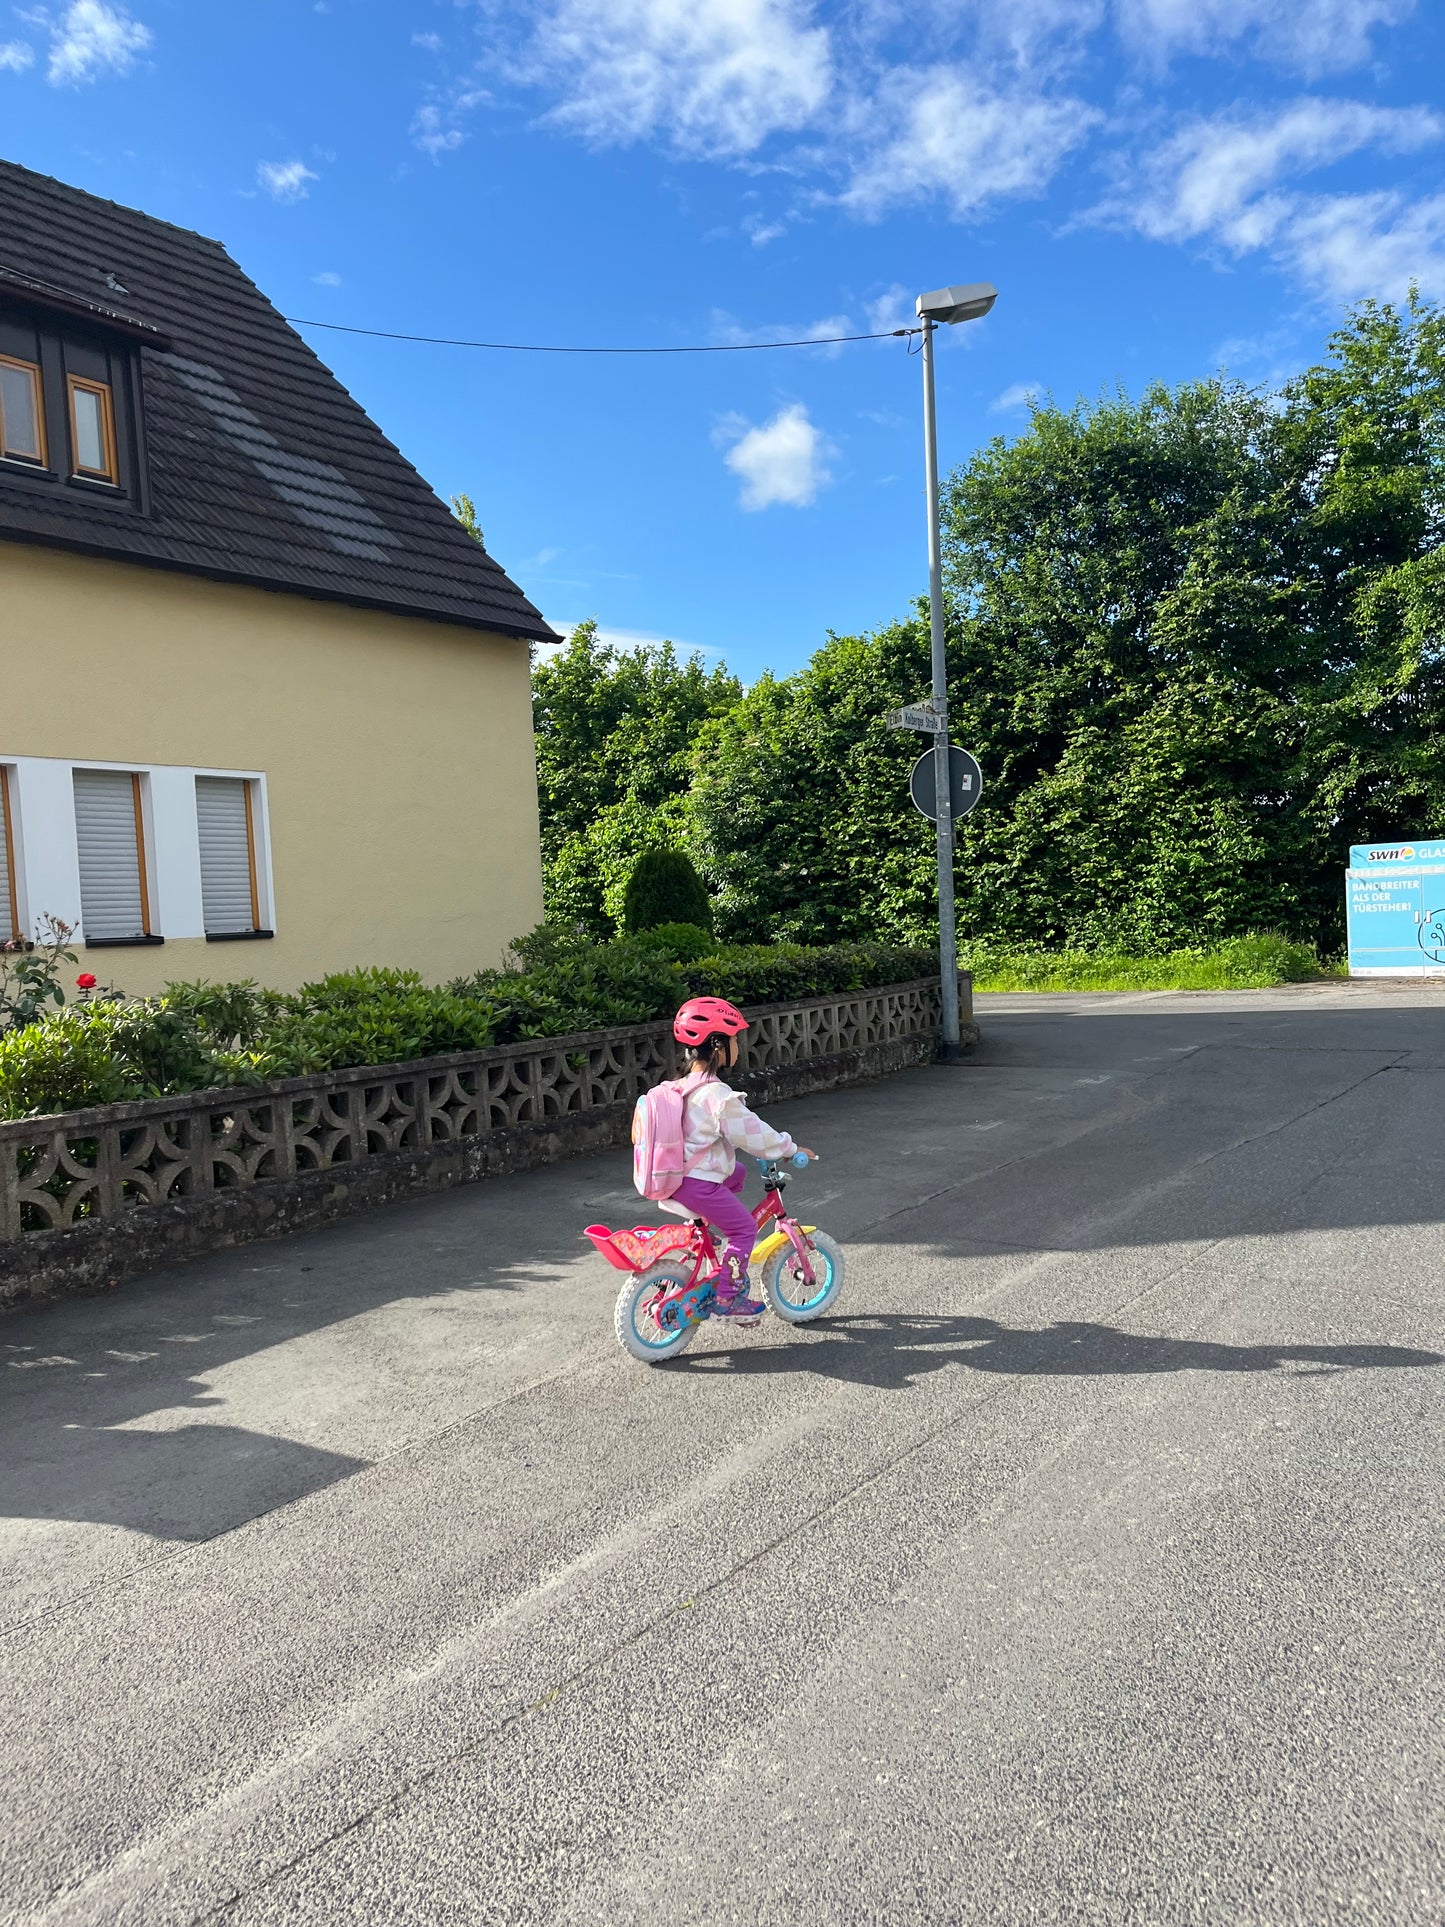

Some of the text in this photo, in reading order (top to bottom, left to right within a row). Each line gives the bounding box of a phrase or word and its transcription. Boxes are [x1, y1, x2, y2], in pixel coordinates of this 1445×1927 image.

[925, 715, 938, 730] Straße
[1368, 850, 1399, 860] swn
[1352, 880, 1419, 891] BANDBREITER
[1352, 892, 1391, 902] ALS DER
[1353, 902, 1411, 912] TÜRSTEHER!
